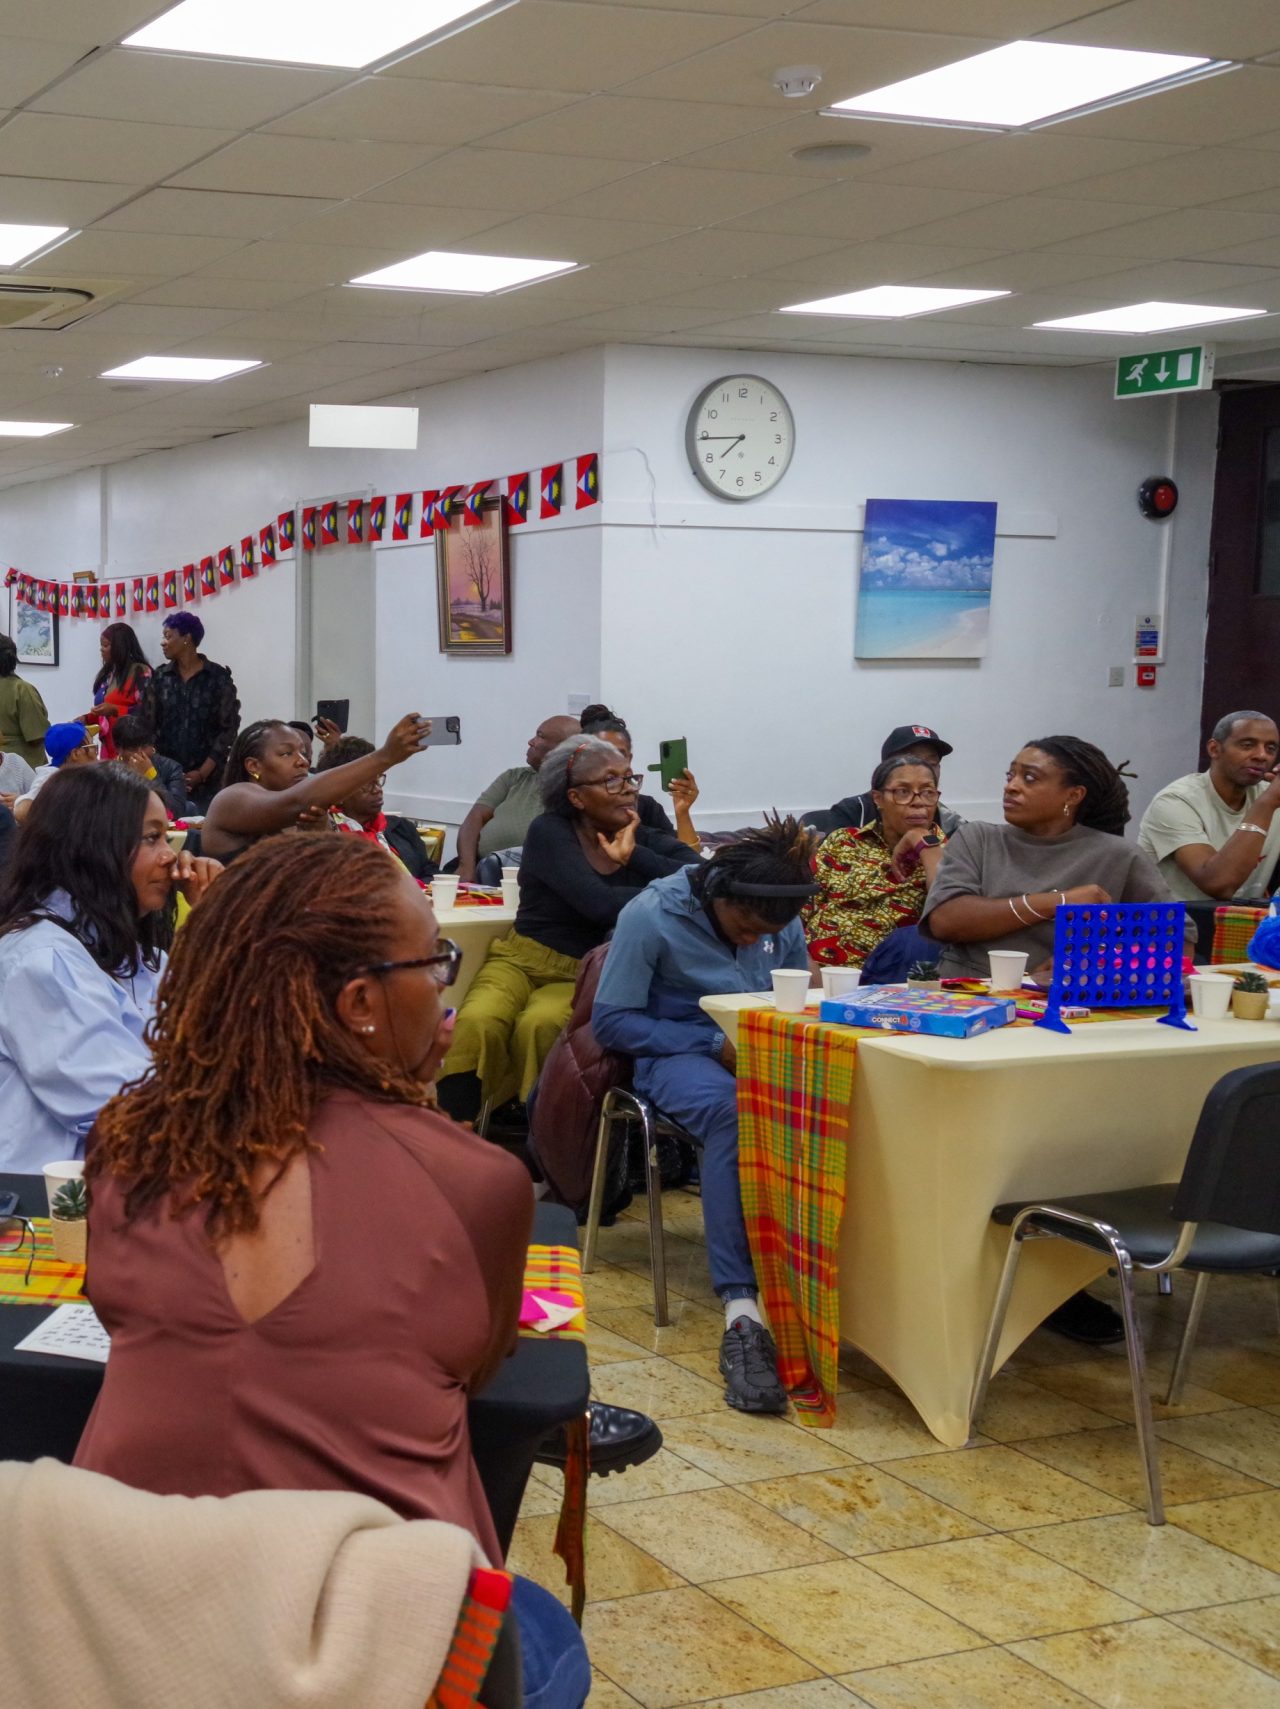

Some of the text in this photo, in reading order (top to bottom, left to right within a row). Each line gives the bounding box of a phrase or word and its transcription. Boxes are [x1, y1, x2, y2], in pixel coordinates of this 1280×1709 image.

[722, 393, 729, 403] 11
[738, 388, 748, 399] 12
[707, 409, 718, 419] 10
[770, 412, 778, 422] 2
[701, 430, 709, 441] 9
[774, 434, 782, 444] 3
[705, 453, 714, 463] 8
[768, 456, 775, 465] 4
[719, 469, 726, 479] 7
[754, 471, 762, 482] 5
[735, 476, 744, 487] 6
